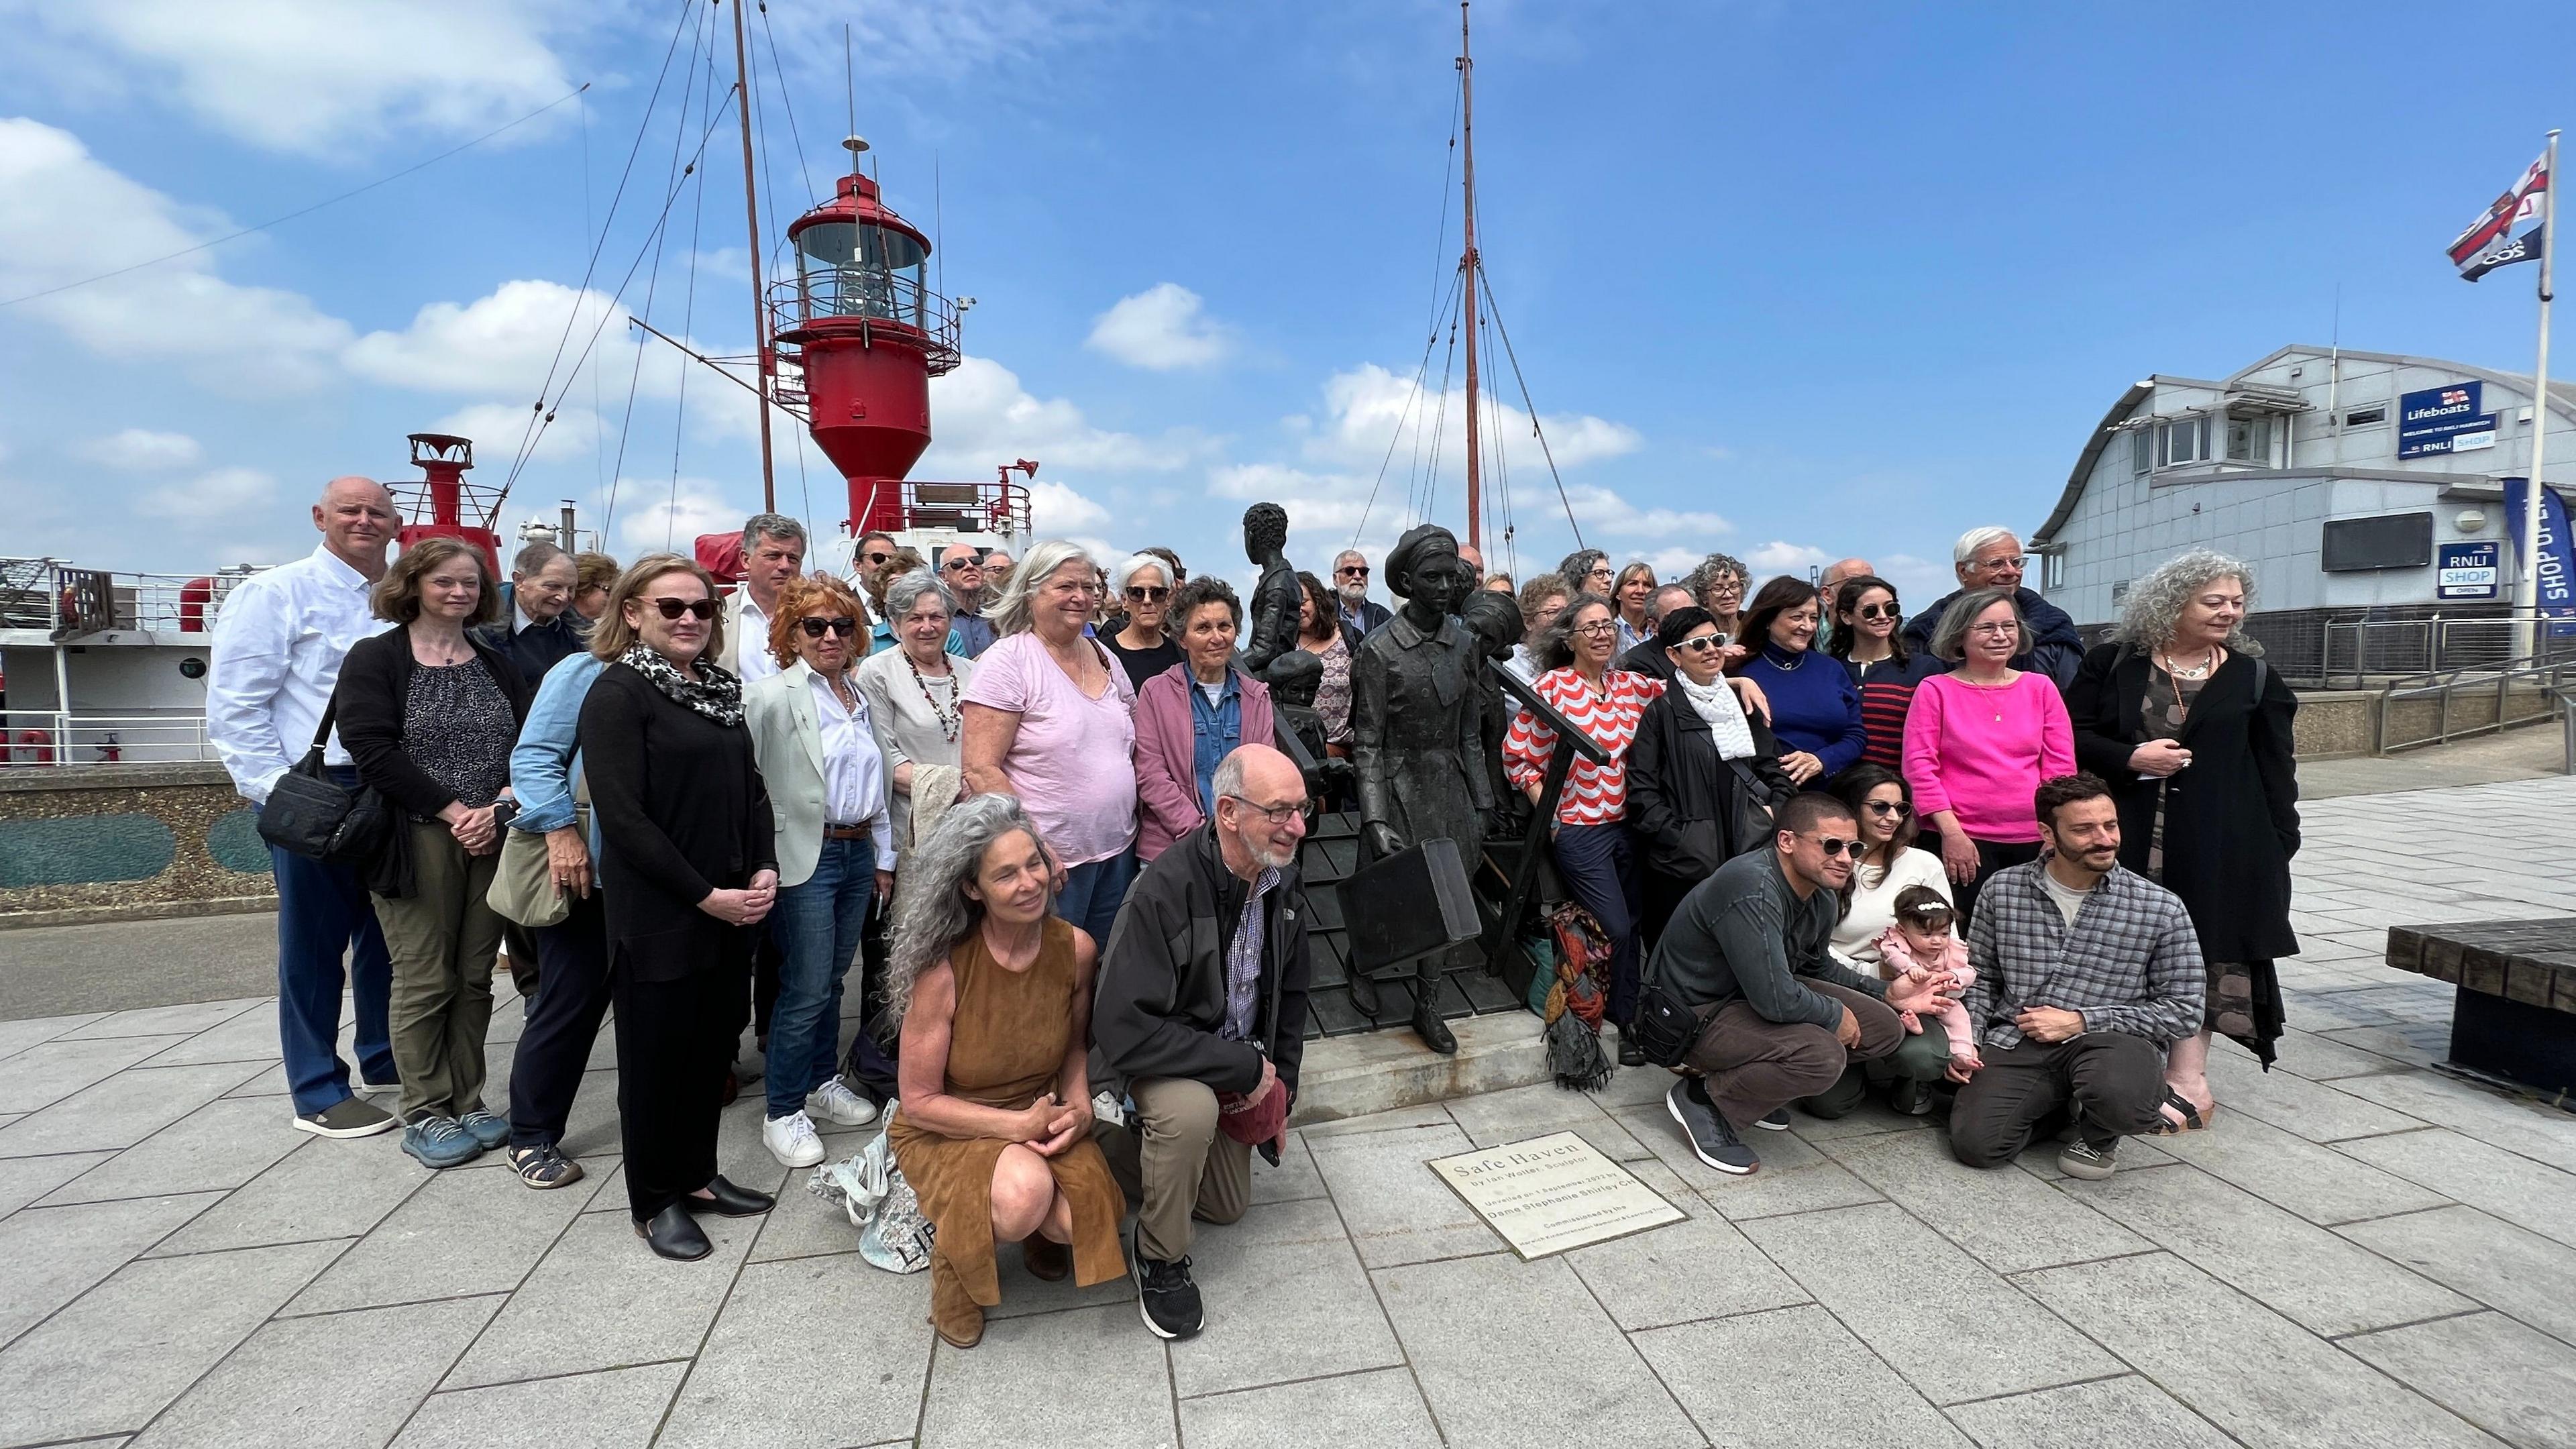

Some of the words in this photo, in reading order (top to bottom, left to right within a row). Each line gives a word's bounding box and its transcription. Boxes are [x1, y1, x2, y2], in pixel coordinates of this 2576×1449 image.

[2408, 404, 2470, 421] Lifeboats
[2402, 428, 2434, 437] WELCOME
[2423, 441, 2451, 451] RNLI
[2458, 435, 2490, 447] SHOP
[2451, 555, 2487, 568] RNLI
[2445, 570, 2490, 582] SHOP
[2536, 551, 2569, 600] SHOP
[1454, 1159, 1506, 1178] Safe
[1509, 1144, 1580, 1165] Haven
[1470, 1179, 1484, 1187] by
[1487, 1175, 1504, 1183] Ian
[1545, 1156, 1588, 1169] Sculptor
[1485, 1194, 1522, 1207] Unveiled
[1542, 1179, 1585, 1193] September
[1585, 1174, 1605, 1183] 2022
[1487, 1207, 1521, 1219] Dame
[1522, 1193, 1578, 1210] Stephanie
[1579, 1183, 1618, 1197] Shirley
[1619, 1179, 1636, 1188] CH
[1544, 1210, 1602, 1229] Commissioned
